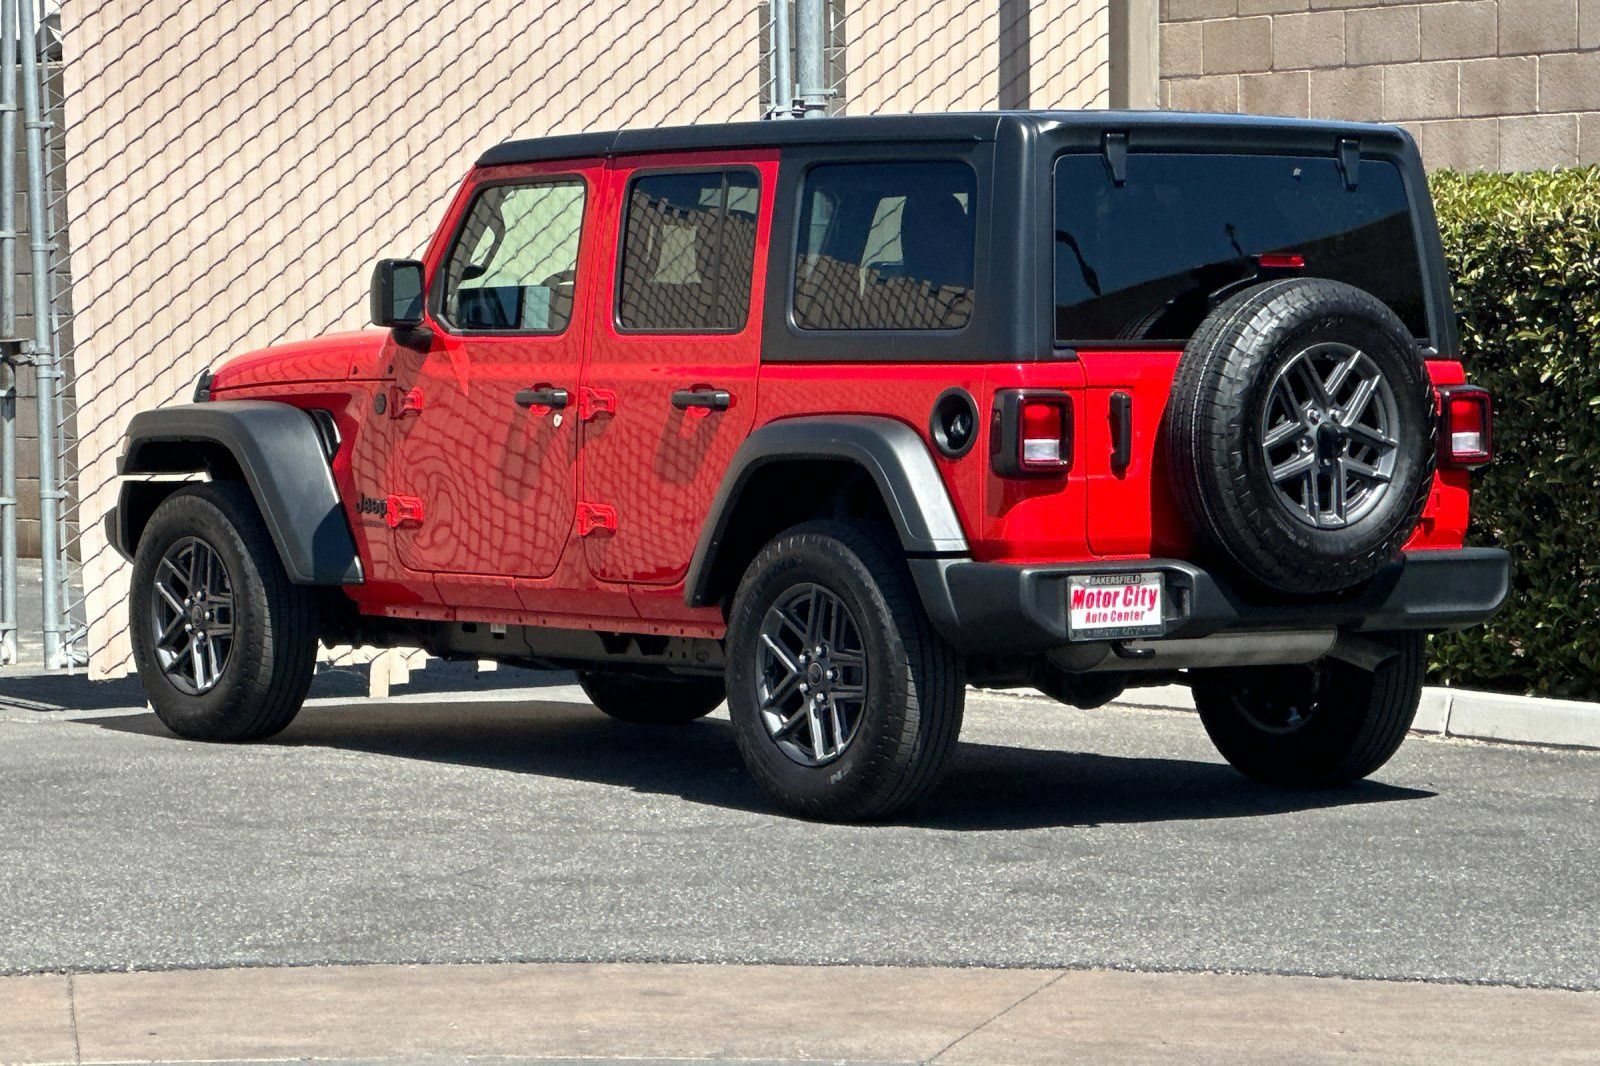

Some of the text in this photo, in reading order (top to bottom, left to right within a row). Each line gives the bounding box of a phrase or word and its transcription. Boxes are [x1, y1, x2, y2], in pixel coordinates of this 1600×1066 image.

[355, 493, 387, 518] Jeep
[1091, 575, 1141, 585] BAKERSFIELD
[1071, 585, 1158, 611] Motor City
[1085, 610, 1145, 624] Auto Center
